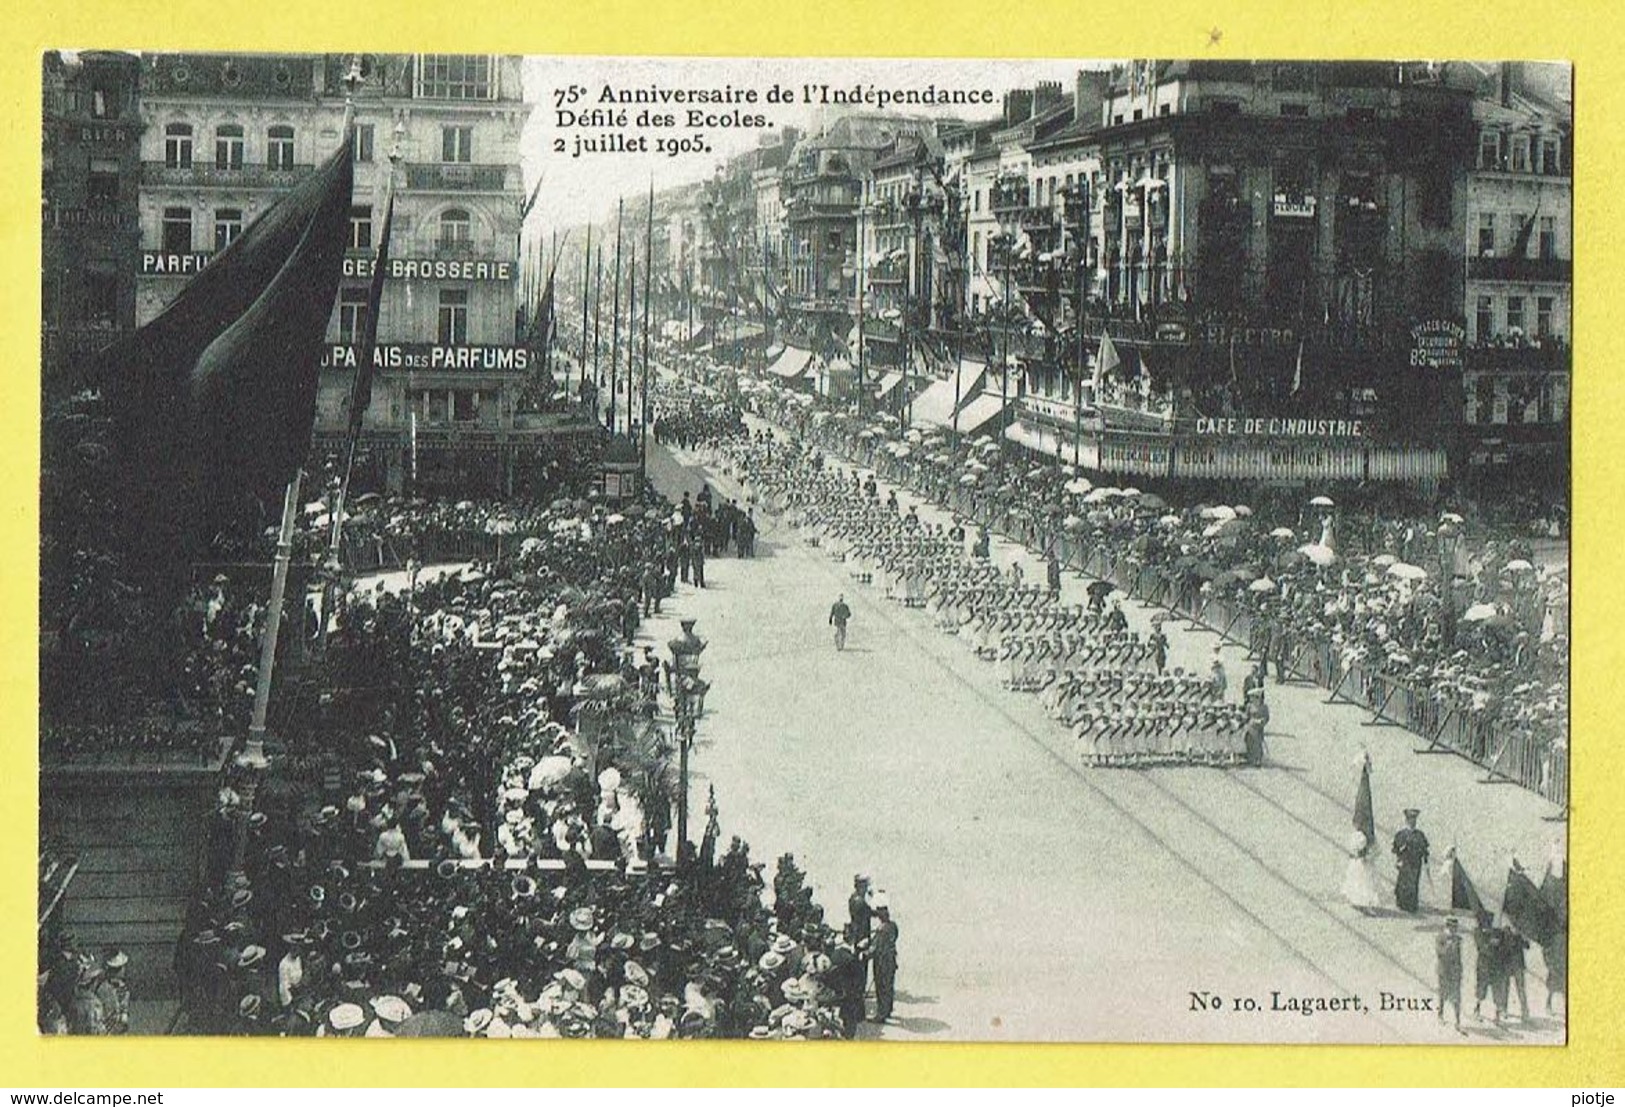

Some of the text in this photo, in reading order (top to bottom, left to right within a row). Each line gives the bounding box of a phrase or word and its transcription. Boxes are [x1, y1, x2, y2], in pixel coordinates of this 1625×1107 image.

[143, 254, 209, 273] PARFU
[332, 346, 402, 367] PAAIS
[405, 355, 429, 368] DES
[430, 347, 528, 369] PARFUMS
[1409, 348, 1427, 367] 83
[1244, 417, 1265, 434] DE
[1269, 417, 1363, 437] L'INDUSTRIE
